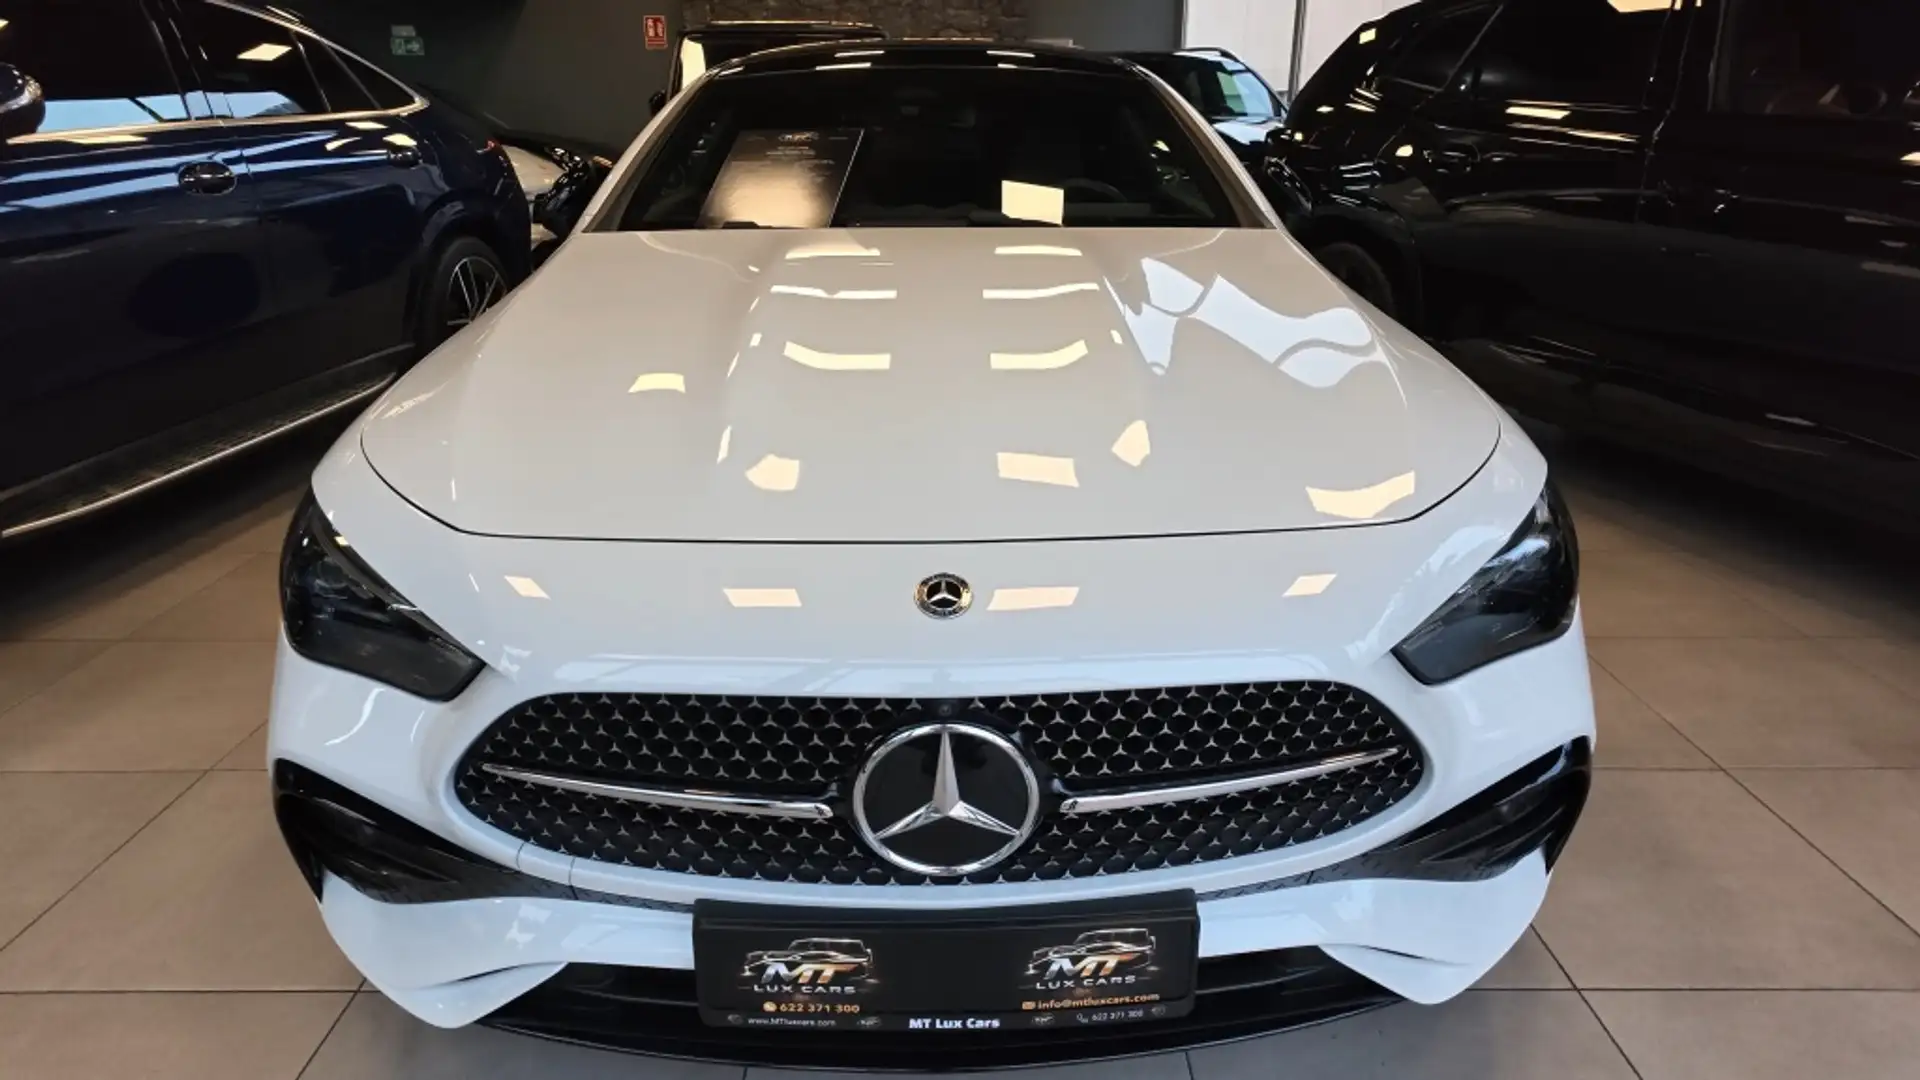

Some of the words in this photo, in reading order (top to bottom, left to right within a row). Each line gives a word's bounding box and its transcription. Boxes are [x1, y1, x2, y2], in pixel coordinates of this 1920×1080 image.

[754, 984, 793, 993] LUX
[801, 985, 857, 994] CARS
[1035, 980, 1075, 990] LUX
[1083, 975, 1136, 986] CARS
[779, 1001, 804, 1012] 622
[808, 1002, 830, 1013] 371
[834, 1003, 860, 1014] 300
[1038, 993, 1160, 1010] info@mtluxcars.com
[909, 1018, 931, 1029] MT
[935, 1018, 962, 1029] Lux
[966, 1017, 1000, 1029] Cars
